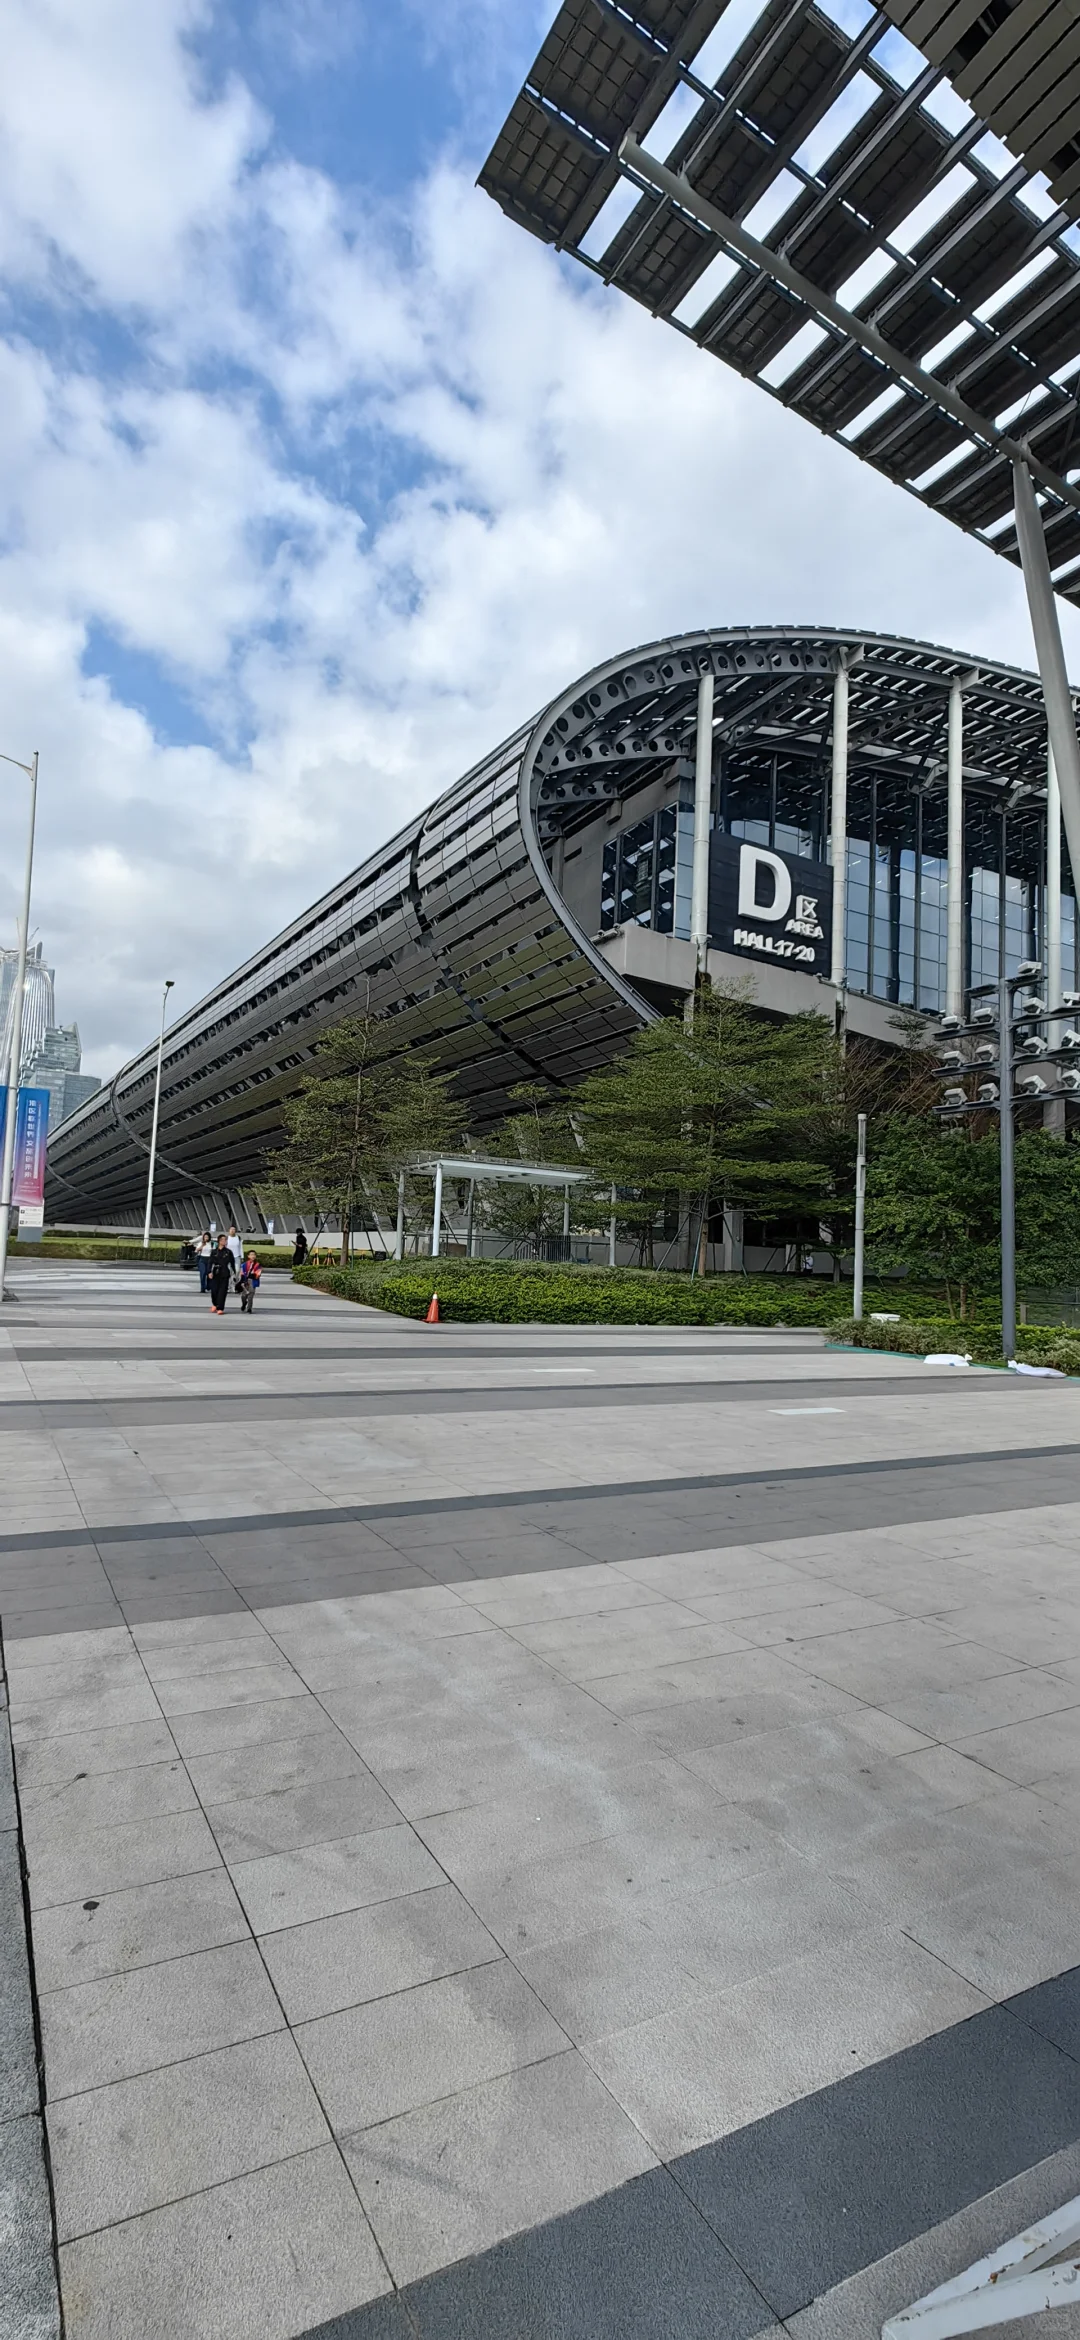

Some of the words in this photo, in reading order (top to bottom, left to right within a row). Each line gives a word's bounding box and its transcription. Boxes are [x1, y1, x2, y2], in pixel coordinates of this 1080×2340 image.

[738, 844, 792, 921] D
[796, 894, 818, 923] 区
[785, 919, 824, 940] AREA
[734, 929, 777, 956] HALL
[774, 940, 815, 962] 17-20
